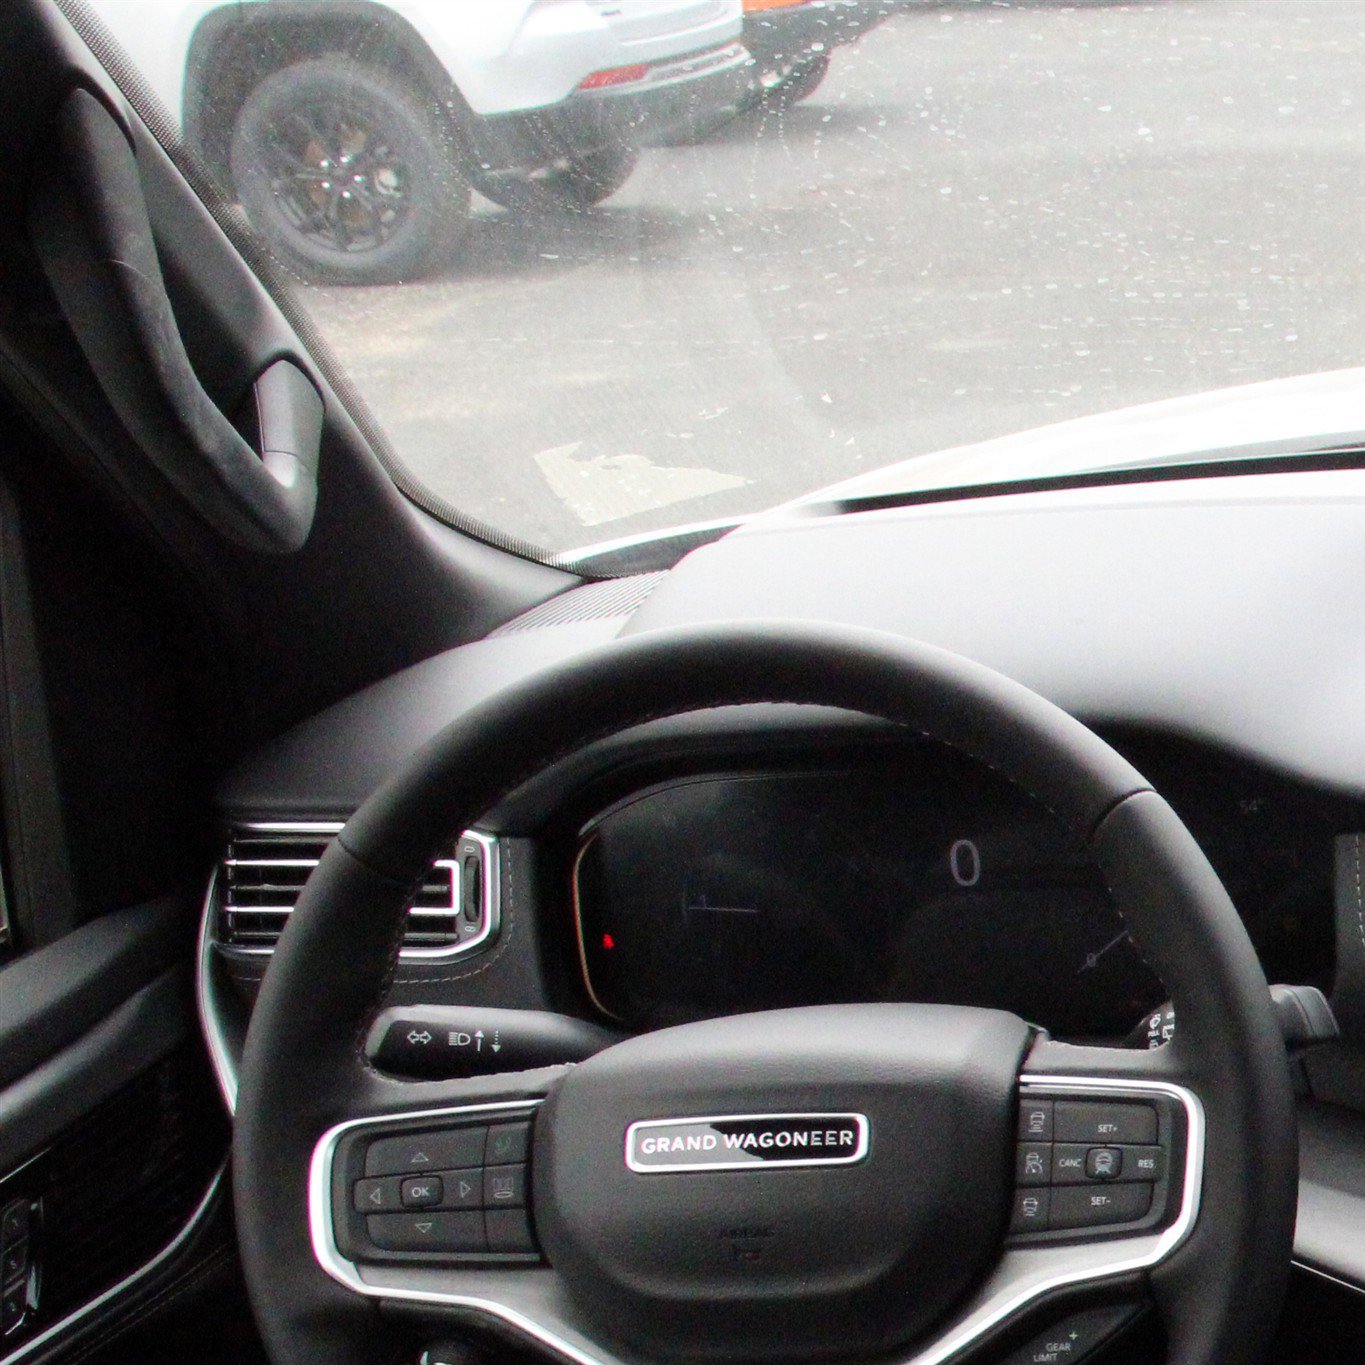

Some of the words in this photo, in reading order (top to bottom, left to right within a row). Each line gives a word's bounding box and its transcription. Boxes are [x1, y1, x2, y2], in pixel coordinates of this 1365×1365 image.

[948, 838, 982, 888] 0
[641, 1135, 717, 1154] GRAND
[723, 1130, 854, 1149] WAGONEER
[1058, 1158, 1082, 1168] CANC
[1138, 1159, 1154, 1169] RES
[411, 1186, 430, 1198] OK
[1045, 1342, 1072, 1352] GEAR
[1033, 1353, 1058, 1363] LIMIT
